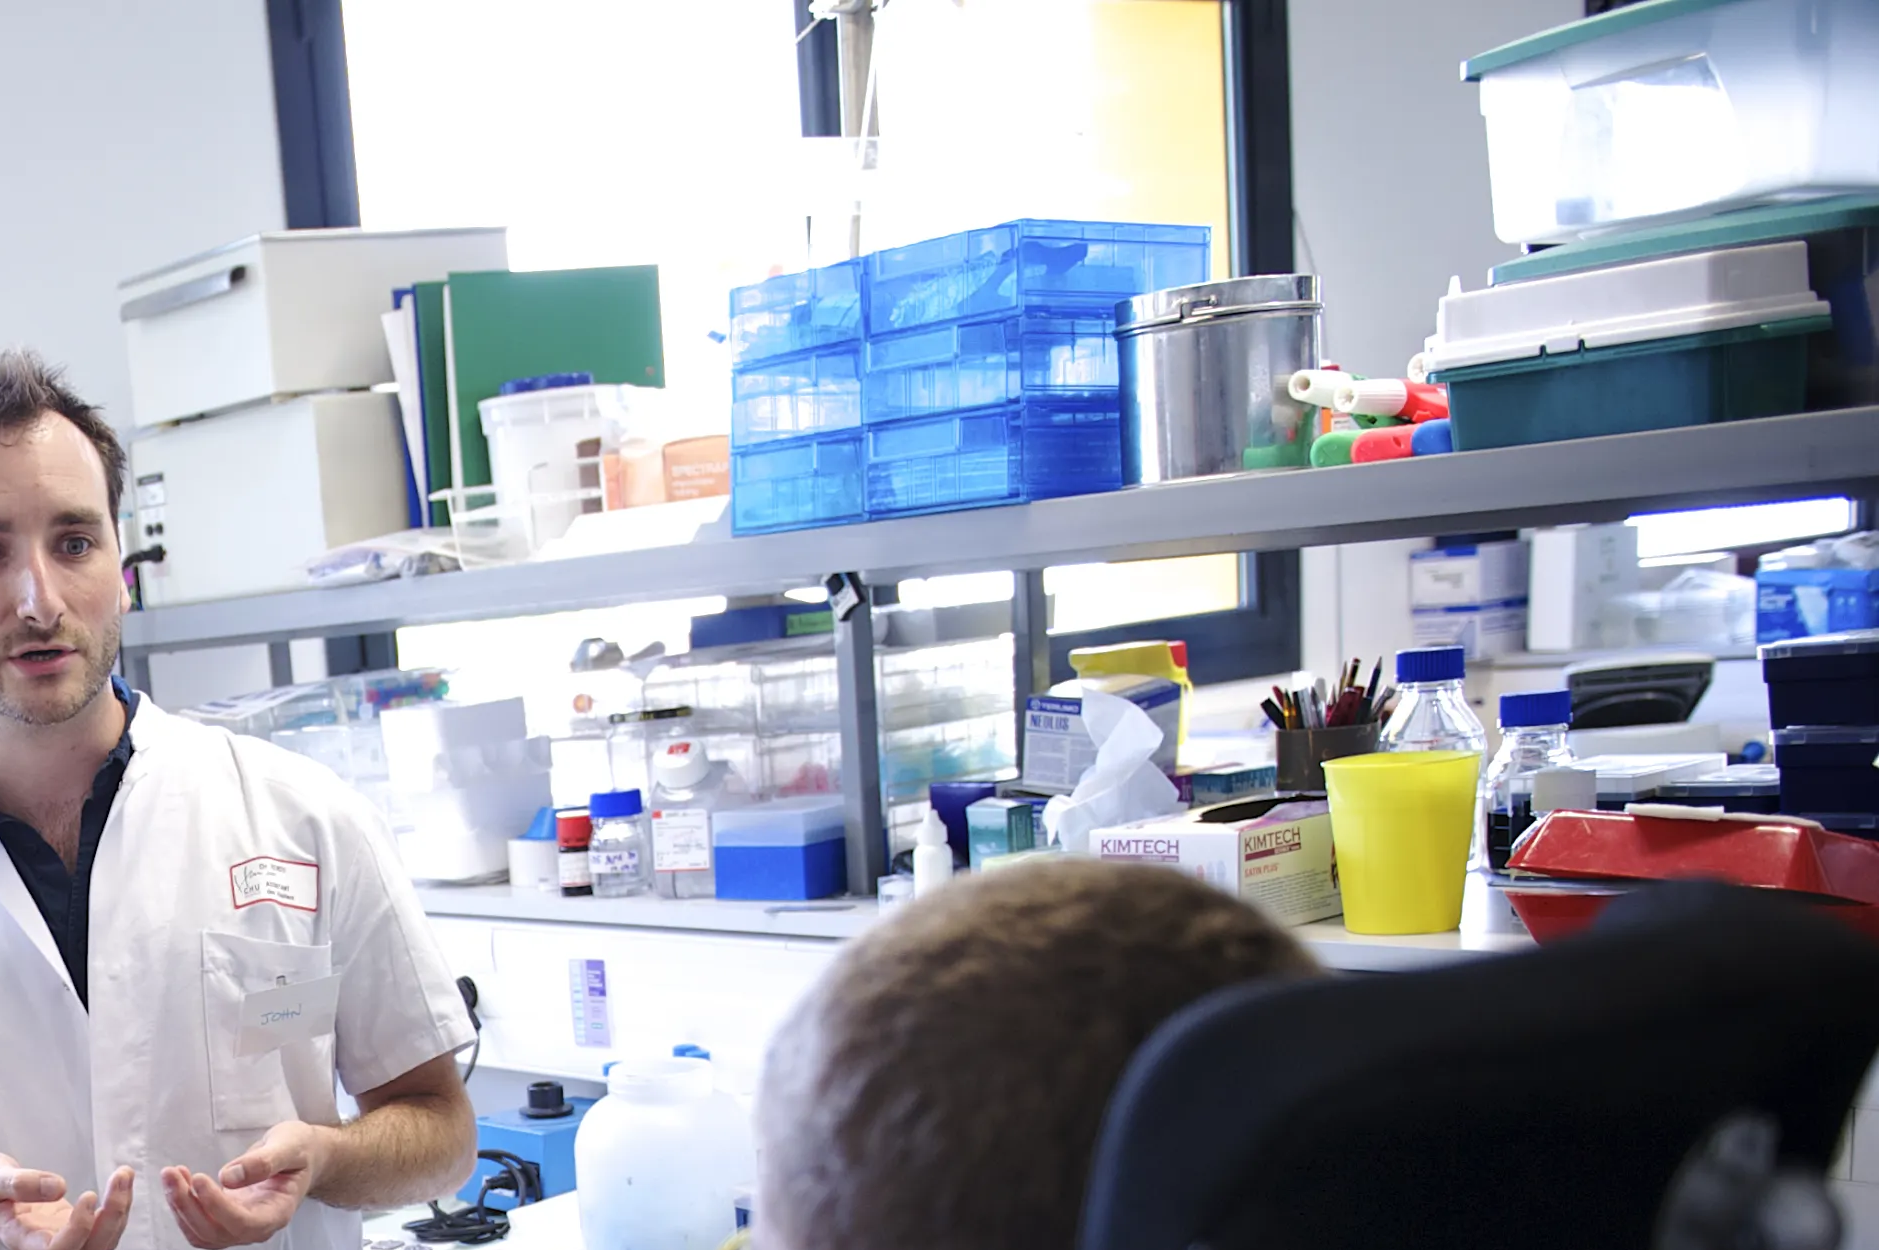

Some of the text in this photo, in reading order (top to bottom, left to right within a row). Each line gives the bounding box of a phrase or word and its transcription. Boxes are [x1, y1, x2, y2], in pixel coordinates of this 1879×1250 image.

[1101, 839, 1179, 854] KIMTECH
[1244, 827, 1301, 852] KIMTECH
[260, 1003, 302, 1026] JOHN
